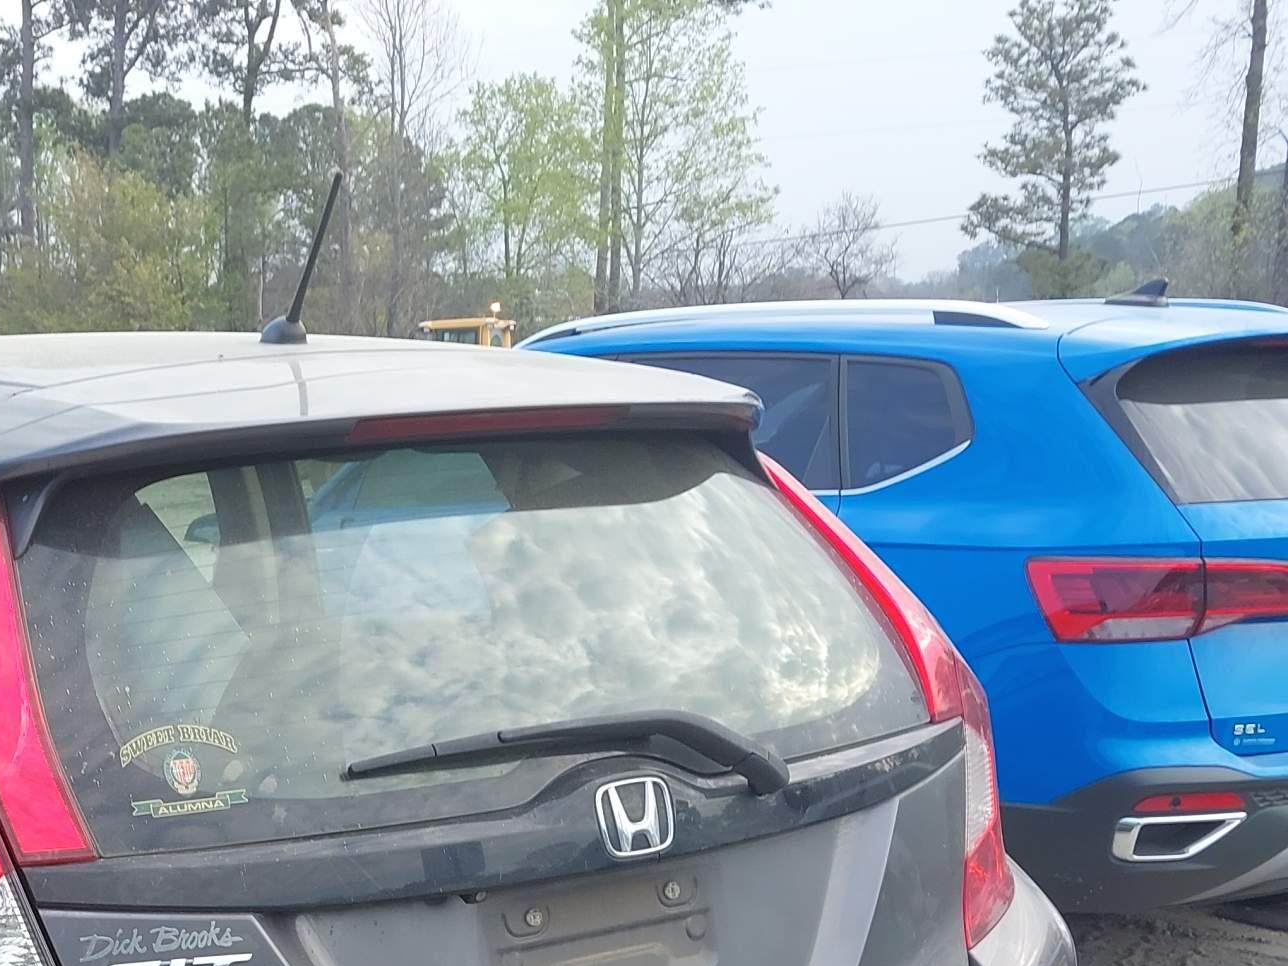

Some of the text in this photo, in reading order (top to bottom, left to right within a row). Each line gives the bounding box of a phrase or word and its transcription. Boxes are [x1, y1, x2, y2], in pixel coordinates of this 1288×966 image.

[120, 725, 238, 767] SWEET BRIAR
[158, 799, 225, 816] ALUMNA
[79, 921, 243, 962] Dick Brooks
